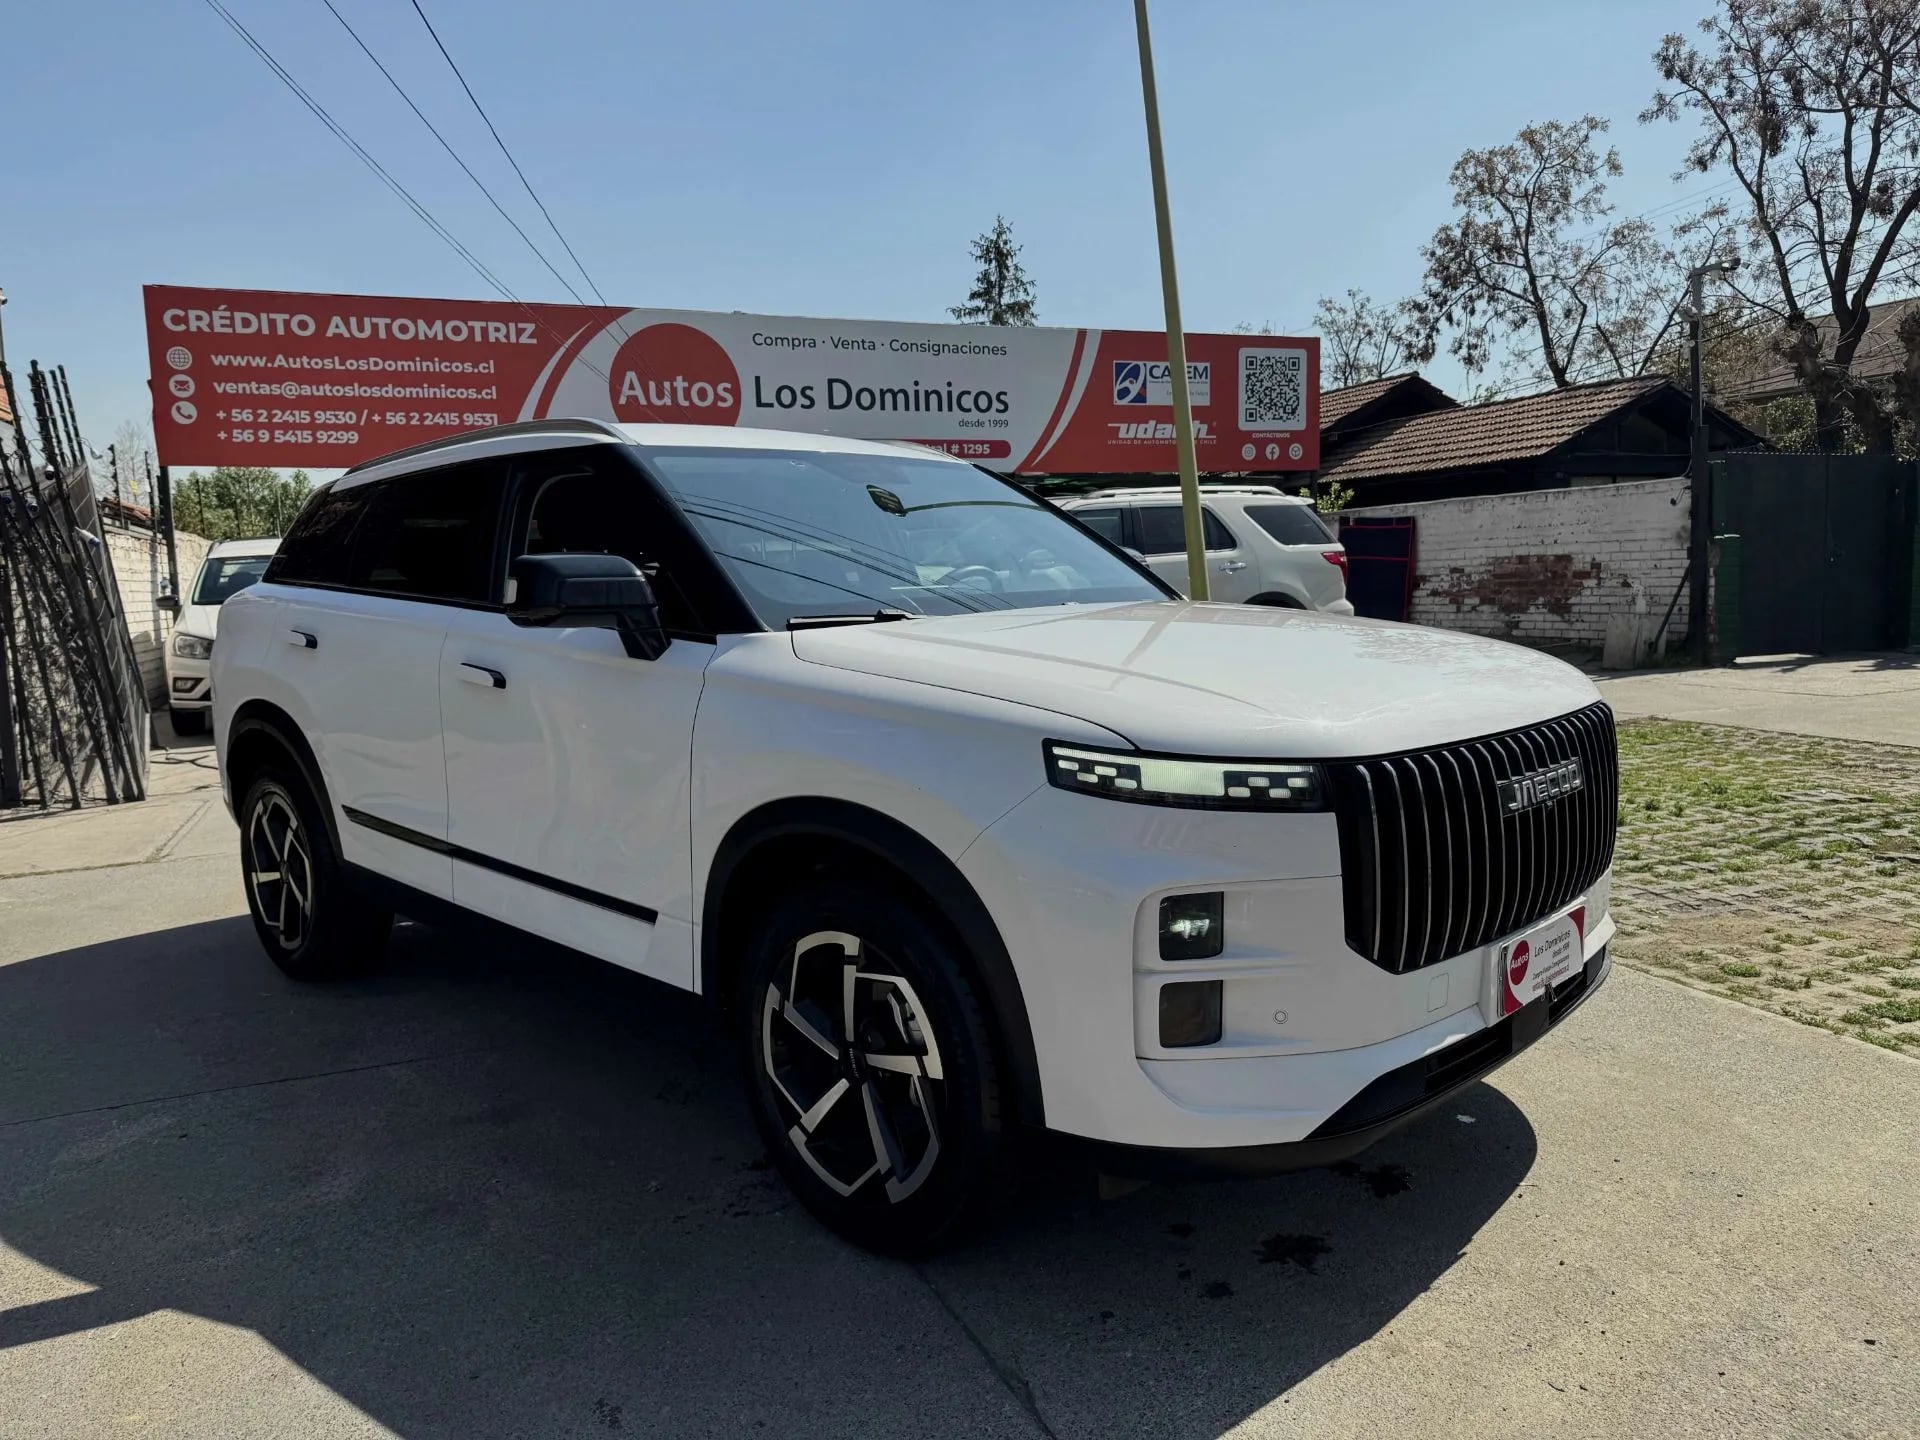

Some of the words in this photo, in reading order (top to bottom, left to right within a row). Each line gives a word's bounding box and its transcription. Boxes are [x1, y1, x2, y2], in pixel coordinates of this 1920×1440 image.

[162, 304, 317, 337] CRÉDITO
[325, 315, 539, 345] AUTOMOTRIZ
[752, 332, 817, 351] Compra
[830, 336, 876, 352] Venta
[889, 339, 1008, 357] Consignaciones
[210, 353, 496, 375] www.AutosLosDominicos.cl
[1148, 364, 1209, 381] CAEM
[213, 379, 498, 401] ventas@autoslosdominicos.cl
[618, 370, 735, 408] Autos
[753, 375, 816, 410] Los
[827, 377, 1010, 414] Dominicos
[231, 409, 254, 423] 56
[256, 409, 269, 423] 2
[271, 410, 311, 424] 2415
[314, 410, 357, 425] 9530
[385, 411, 407, 425] 56
[409, 411, 420, 426] 2
[423, 412, 460, 426] 2415
[463, 412, 498, 426] 9531
[958, 418, 985, 428] desde
[987, 419, 1009, 428] 1999
[232, 429, 255, 443] 56
[258, 429, 270, 443] 9
[274, 430, 313, 444] 5415
[316, 430, 360, 445] 9299
[1107, 419, 1217, 439] udah
[962, 443, 991, 455] 1295
[1510, 952, 1529, 969] Autos
